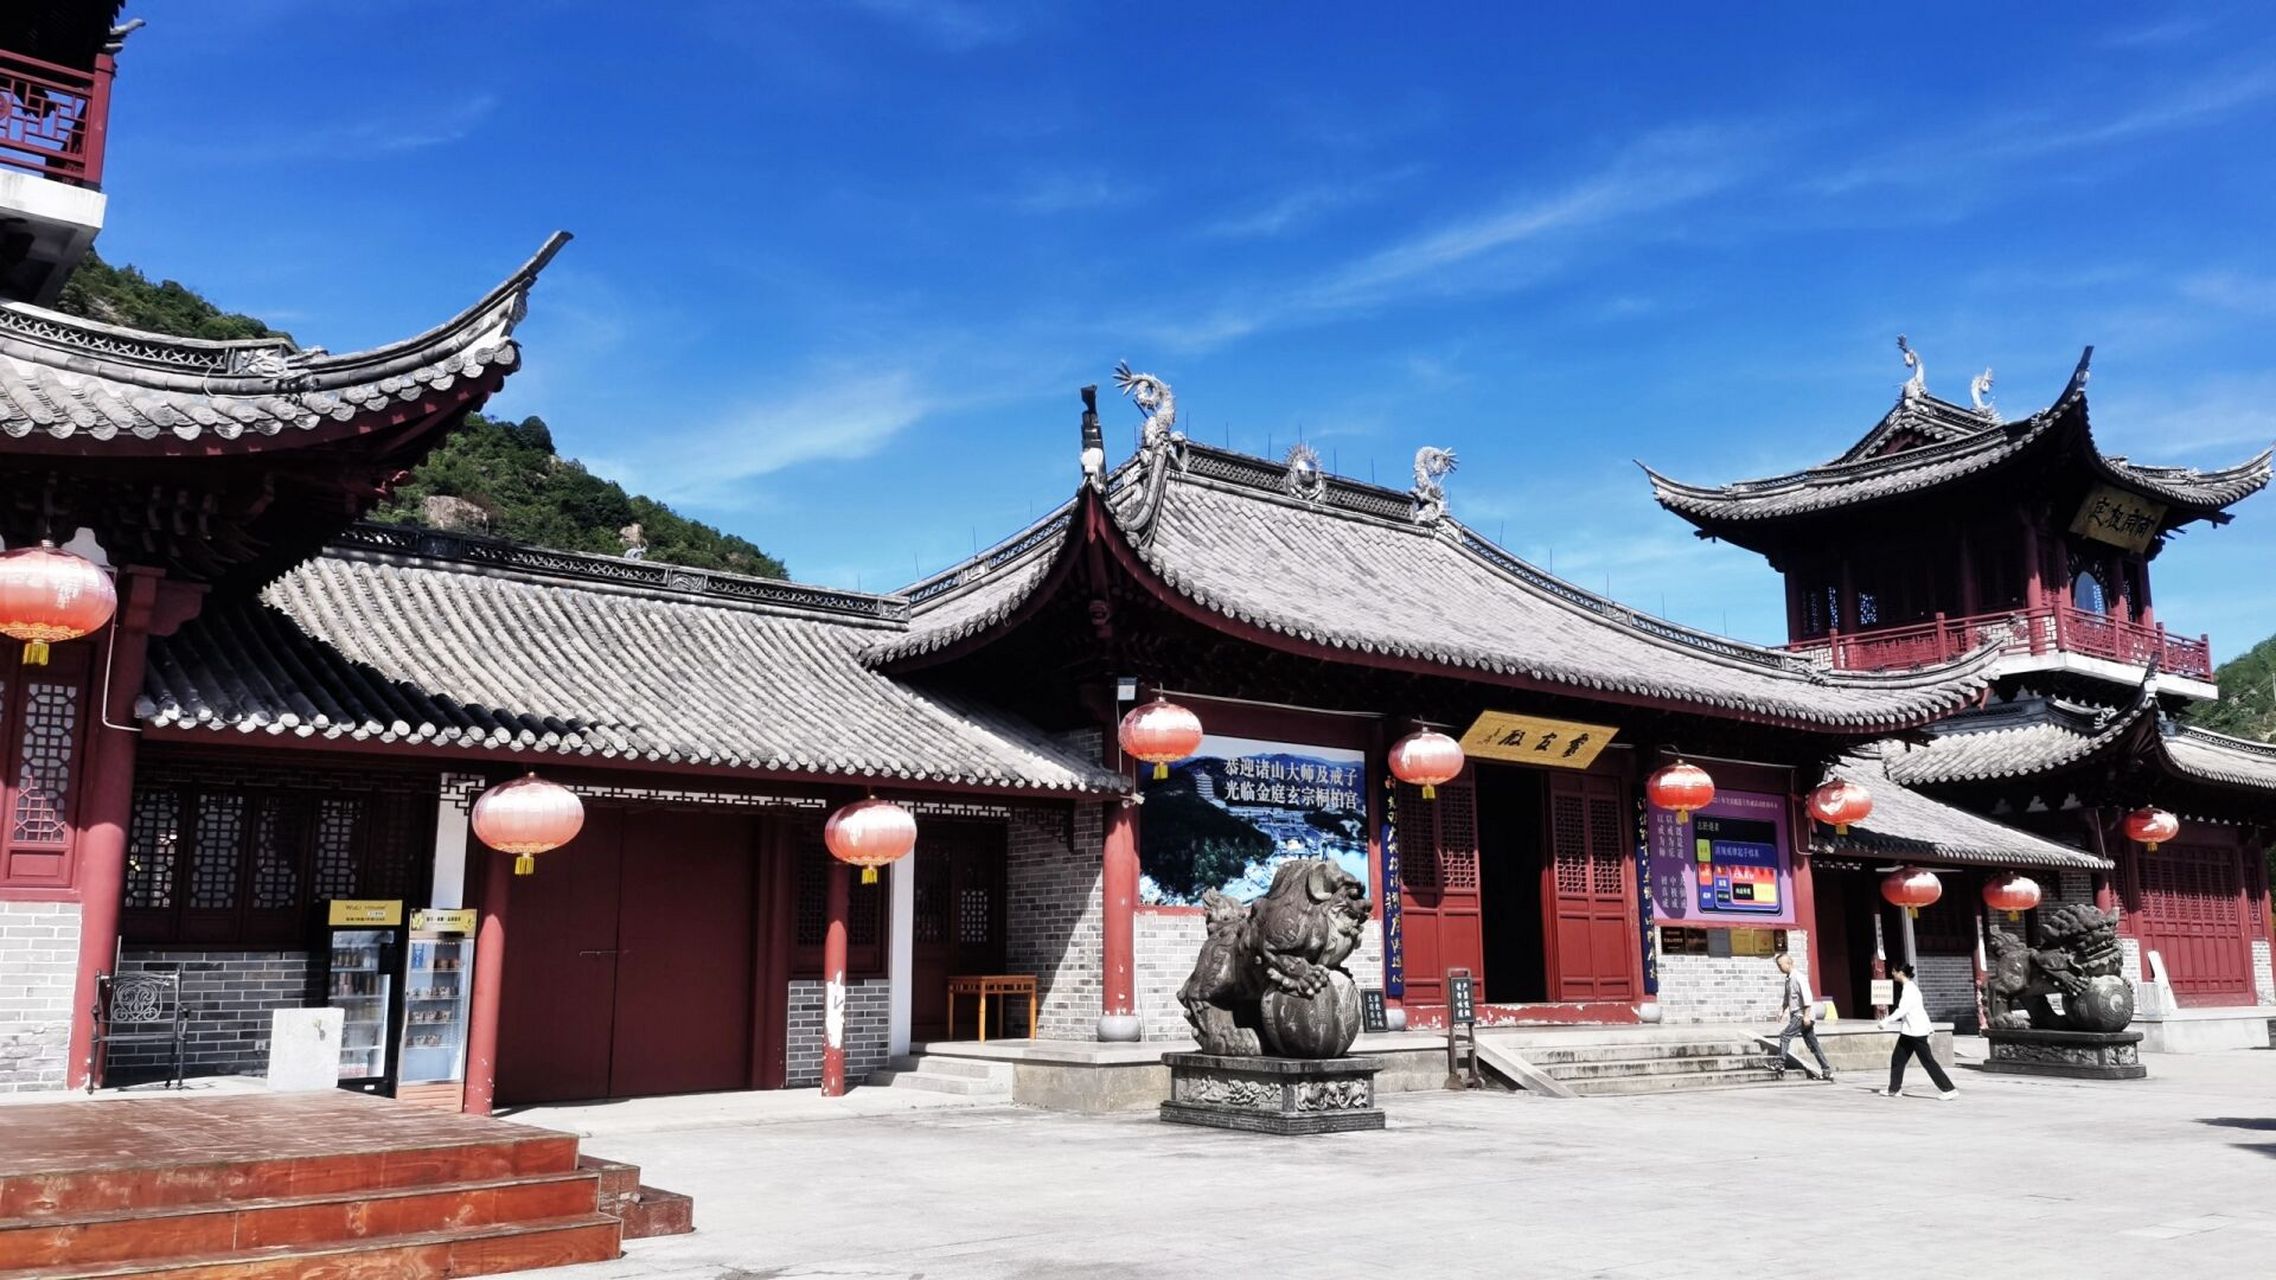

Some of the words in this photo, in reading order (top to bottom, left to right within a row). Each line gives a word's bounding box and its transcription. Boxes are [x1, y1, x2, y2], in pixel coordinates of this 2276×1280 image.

[1224, 758, 1357, 786] 恭迎诸山大师及戒子
[1224, 780, 1358, 810] 光临金庭玄宗桐柏宫
